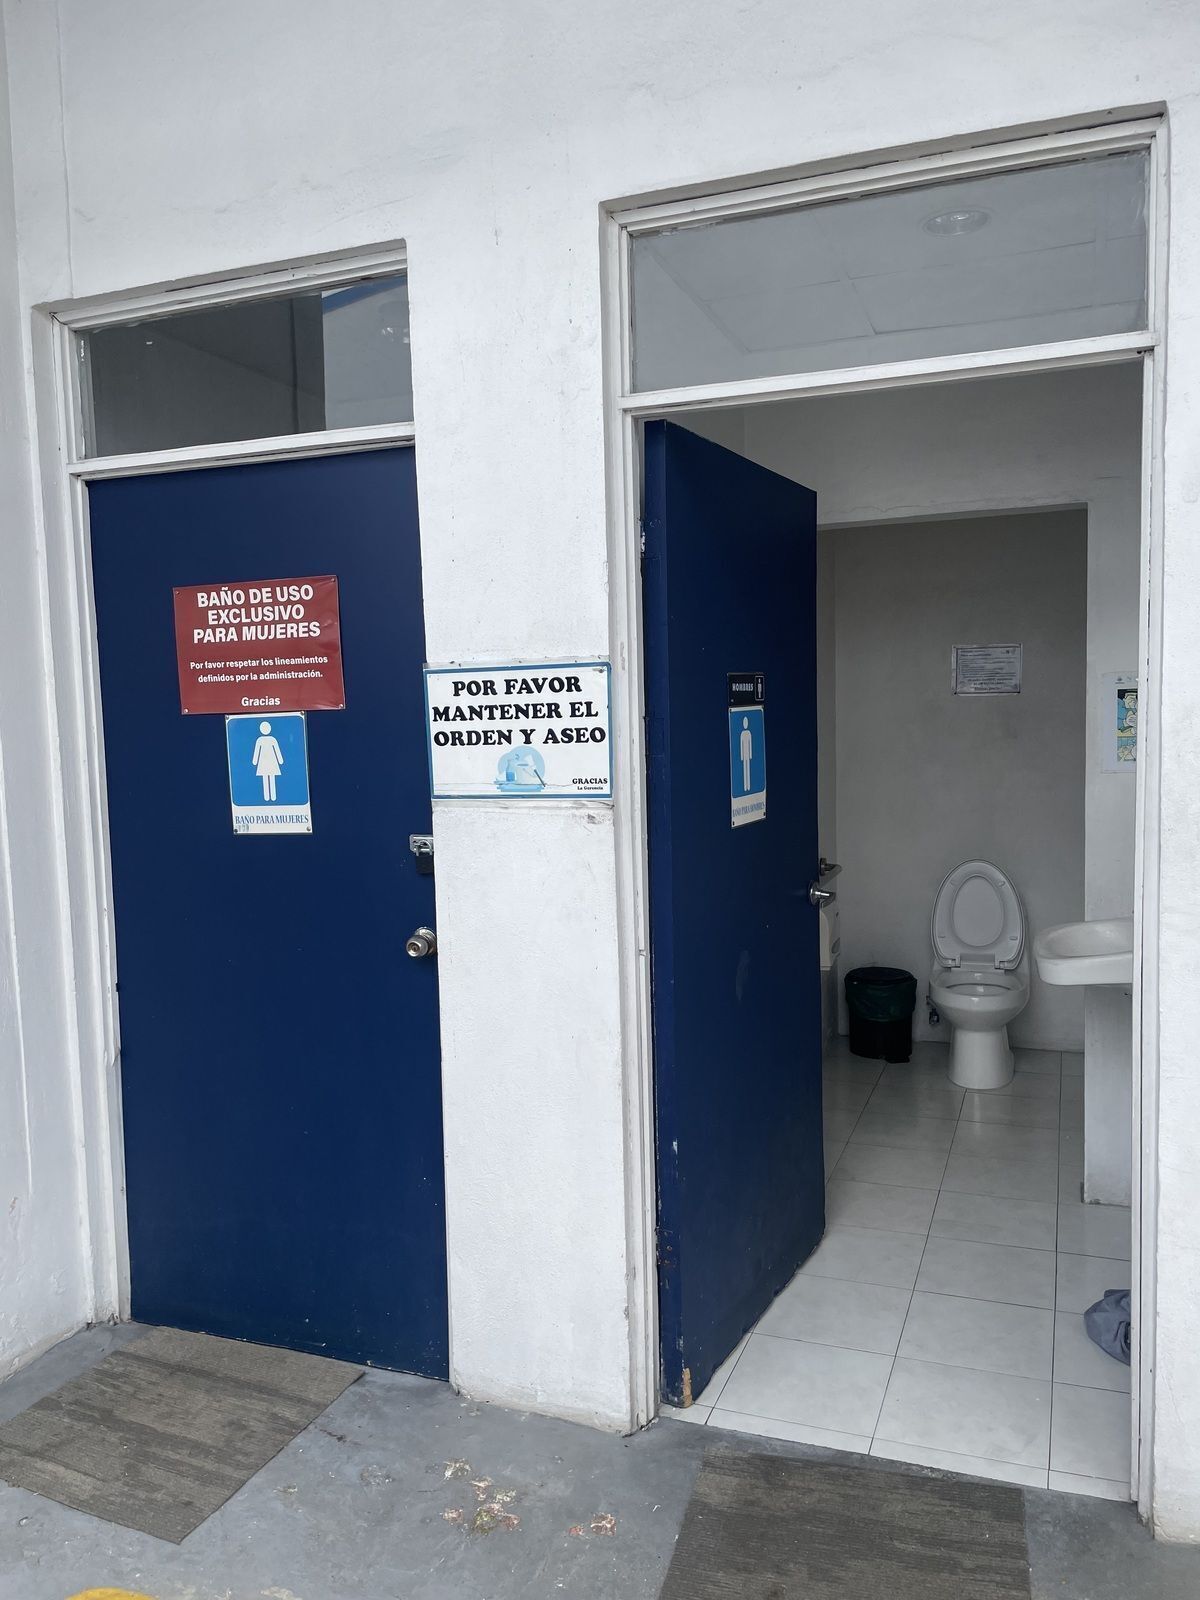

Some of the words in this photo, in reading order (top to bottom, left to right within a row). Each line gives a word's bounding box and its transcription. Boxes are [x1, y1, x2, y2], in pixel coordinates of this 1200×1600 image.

[197, 587, 245, 607] BAÑO
[249, 588, 273, 604] DE
[276, 584, 314, 602] USO
[208, 604, 305, 625] EXCLUSIVO
[193, 627, 238, 644] PARA
[242, 621, 321, 641] MUJERES
[190, 661, 204, 669] Por
[204, 660, 225, 669] favor
[226, 658, 260, 670] respetar
[261, 657, 274, 666] los
[274, 655, 328, 665] lineamientos
[198, 672, 235, 683] definidos
[235, 673, 249, 683] por
[250, 672, 258, 681] la
[259, 669, 323, 681] administración.
[452, 679, 498, 697] POR
[504, 676, 582, 695] FAVOR
[241, 695, 281, 707] Gracias
[432, 702, 562, 722] MANTENER
[569, 701, 599, 718] EL
[433, 729, 513, 747] ORDEN
[519, 728, 537, 745] Y
[543, 726, 606, 745] ASEO
[235, 814, 255, 824] BAÑO
[256, 815, 275, 824] PARA
[275, 814, 309, 824] MUJERES
